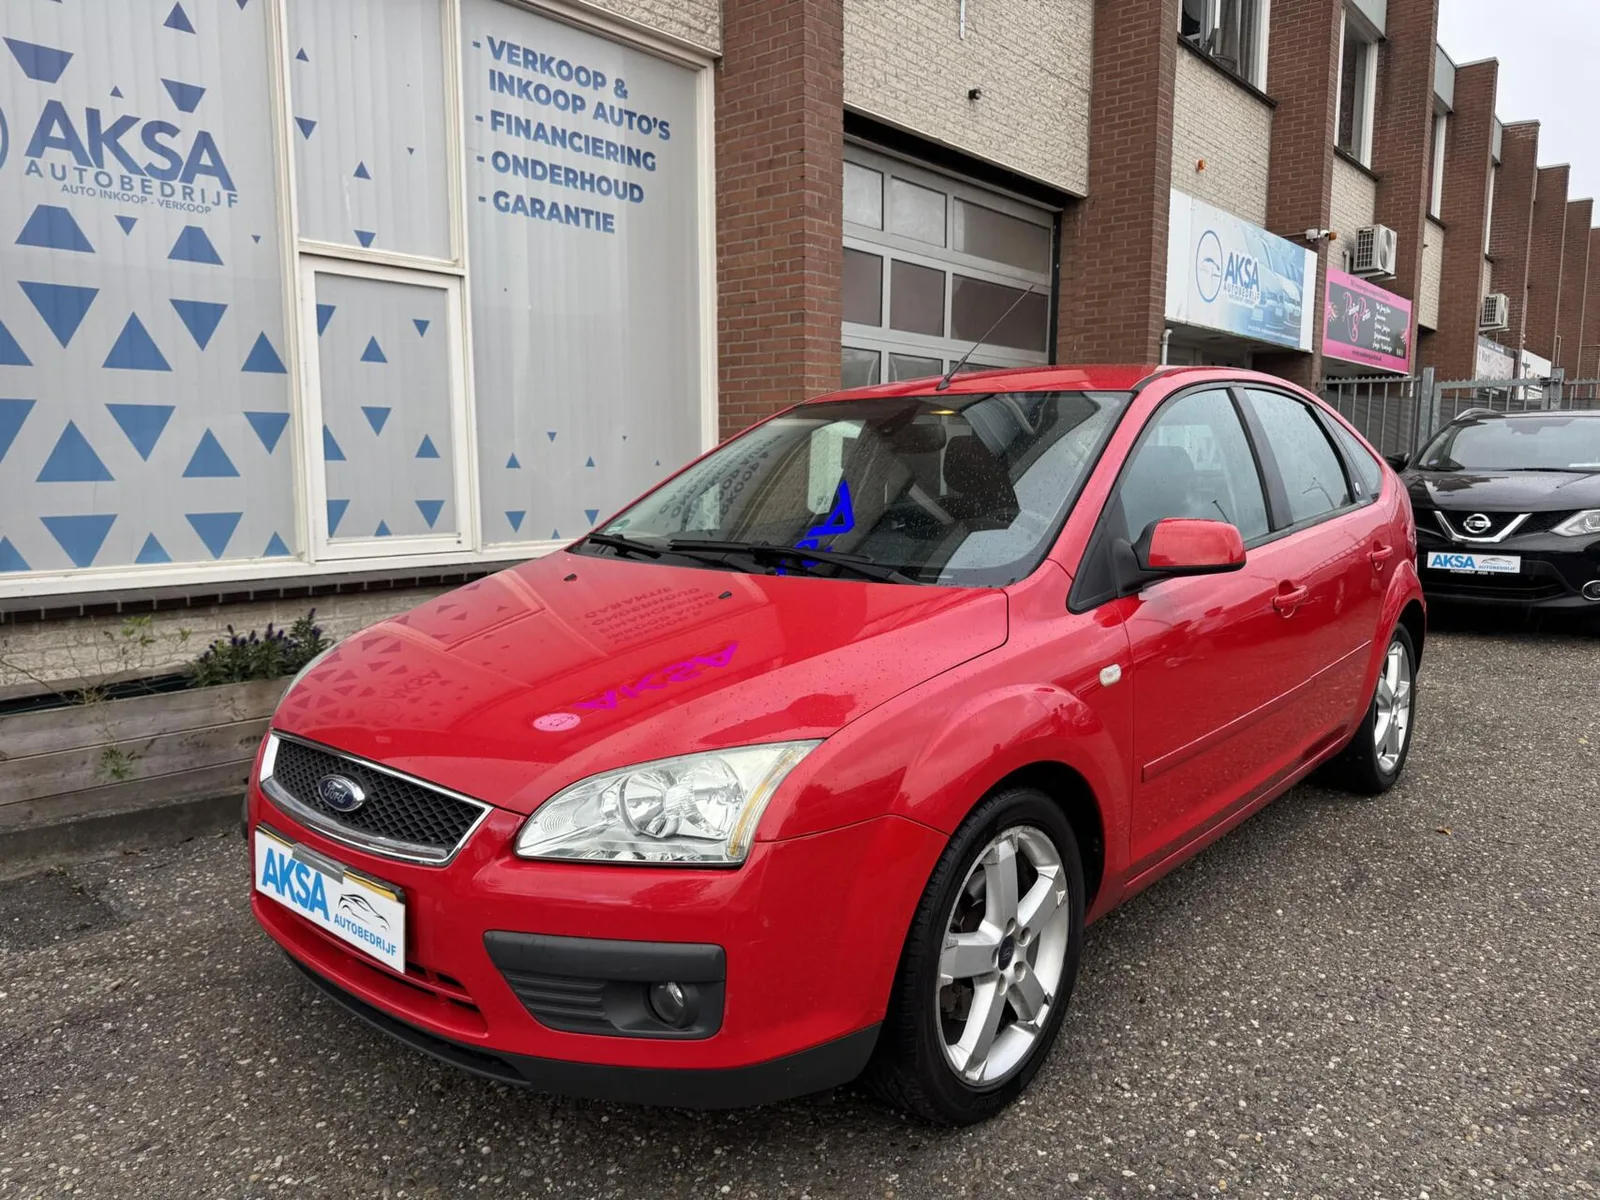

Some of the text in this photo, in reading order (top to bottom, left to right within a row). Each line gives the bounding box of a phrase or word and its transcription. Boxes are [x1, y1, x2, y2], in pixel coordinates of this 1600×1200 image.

[486, 36, 607, 91] VERKOOP
[613, 78, 629, 100] &
[489, 69, 671, 140] INKOOP AUTO'S
[24, 99, 237, 192] AKSA
[490, 109, 656, 172] FINANCIERING
[24, 159, 238, 208] AUTOBEDRIJF
[61, 183, 96, 198] AUTO
[99, 190, 147, 205] INKOOP
[157, 199, 212, 214] VERKOOP
[491, 150, 644, 204] ONDERHOUD
[492, 190, 615, 234] GARANTIE
[1224, 251, 1260, 292] AKSA
[1431, 554, 1475, 569] AKSA
[323, 780, 349, 804] Ford
[261, 846, 331, 923] AKSA
[333, 913, 397, 956] AUTOBEDRIJF
